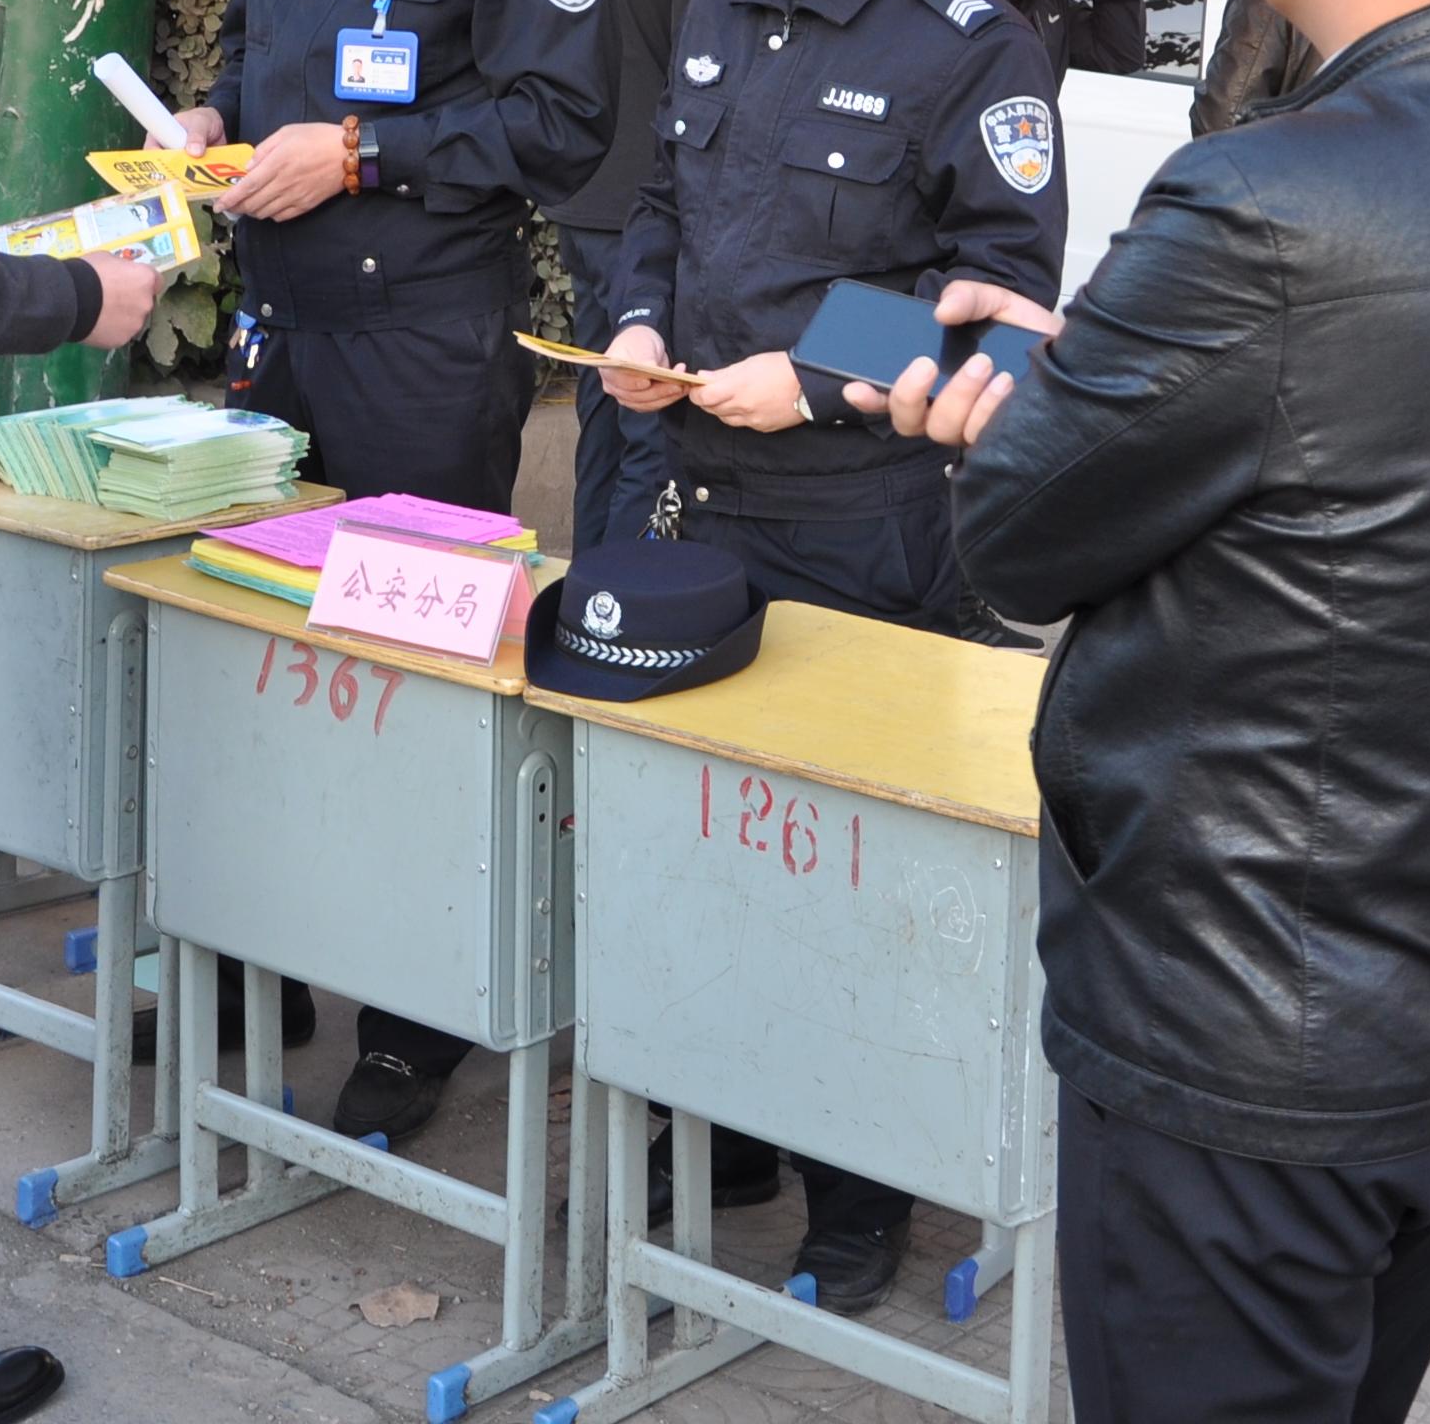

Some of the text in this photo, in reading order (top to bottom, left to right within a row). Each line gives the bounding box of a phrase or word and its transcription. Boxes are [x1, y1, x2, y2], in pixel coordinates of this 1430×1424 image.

[340, 559, 479, 629] 公安分局
[255, 636, 405, 737] 1367
[700, 763, 862, 891] 1261
